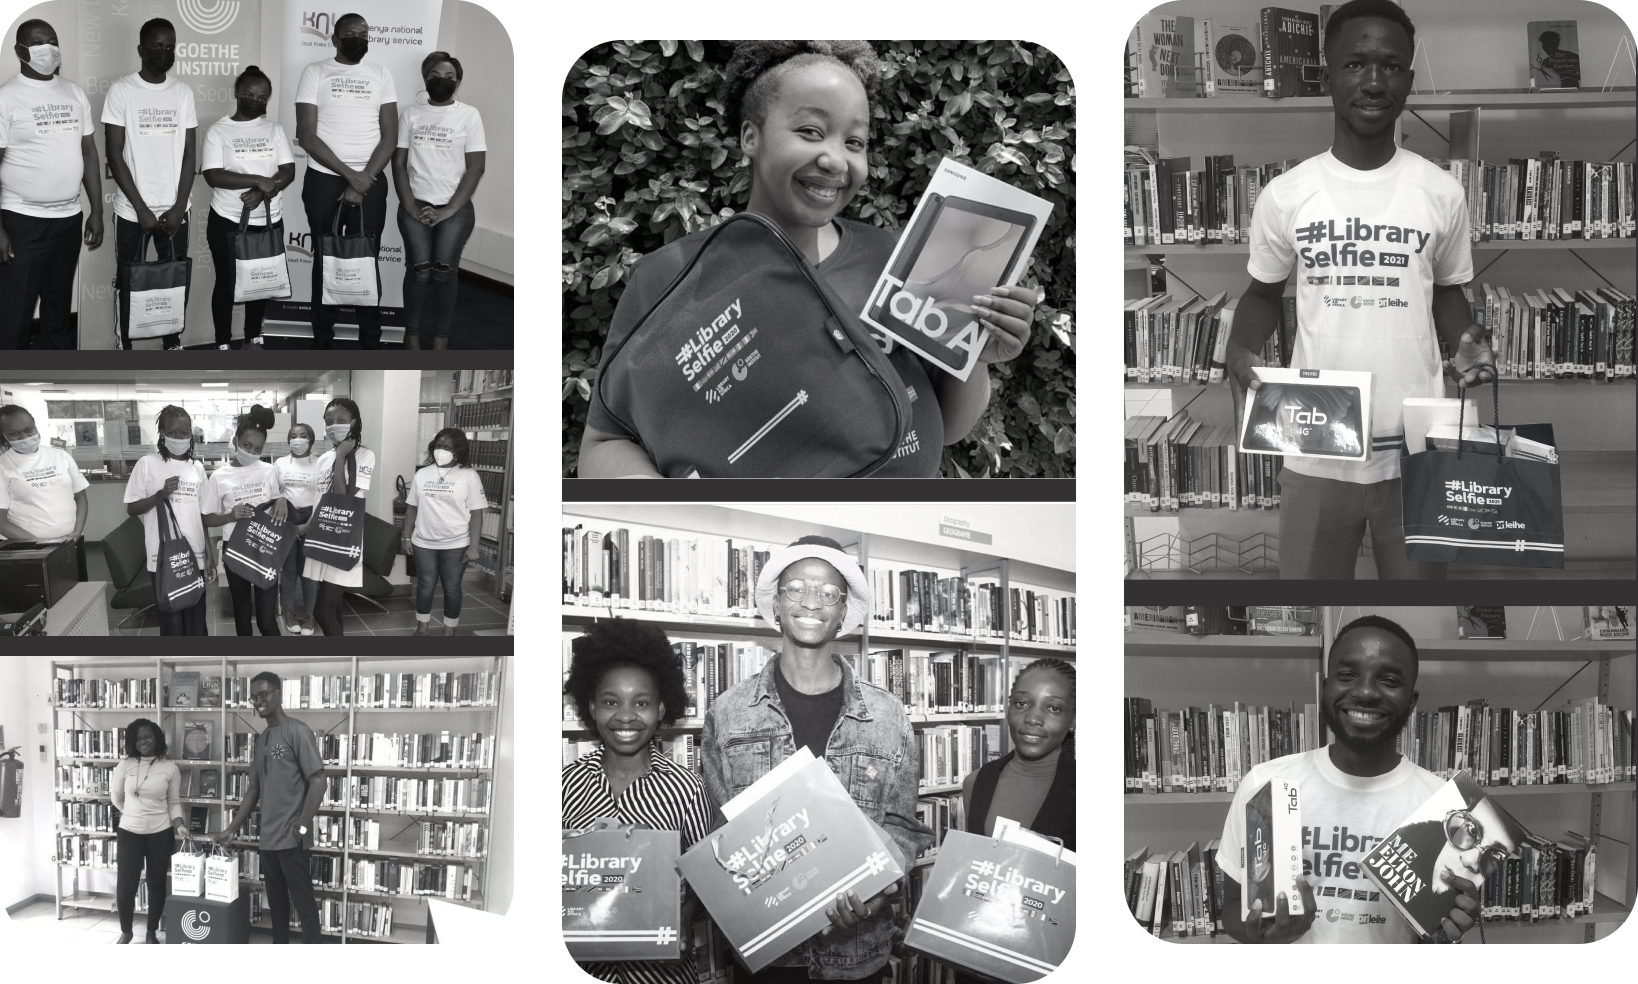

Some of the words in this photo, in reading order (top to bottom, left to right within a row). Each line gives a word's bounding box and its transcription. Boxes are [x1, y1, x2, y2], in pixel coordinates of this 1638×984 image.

[368, 25, 389, 34] enya
[391, 26, 423, 34] national
[1160, 20, 1175, 32] THE
[1282, 21, 1313, 36] ADICHIE
[368, 36, 390, 46] brary
[1154, 32, 1183, 46] WOMAN
[176, 43, 240, 58] GOETHE
[1160, 49, 1180, 64] NEXT
[176, 61, 240, 76] INSTITUT
[1218, 79, 1258, 87] AMERI
[197, 84, 236, 102] Seou
[31, 104, 73, 113] #Library
[34, 112, 60, 120] Selfie
[138, 108, 177, 116] #Library
[944, 167, 967, 180] SAMSUNG
[1296, 217, 1430, 254] #Library
[1300, 242, 1376, 268] Selfie
[1384, 256, 1404, 264] 2021
[876, 274, 948, 338] Tab
[675, 298, 742, 365] #Library
[682, 340, 723, 382] Selfie
[724, 328, 738, 342] 2020
[1284, 406, 1327, 425] Tab
[892, 441, 920, 458] TITUT
[1445, 480, 1512, 498] #Library
[1446, 491, 1485, 504] Selfie
[319, 512, 338, 520] Selfie
[321, 506, 354, 518] #Library
[943, 515, 970, 528] Geography
[250, 520, 282, 542] #Library
[943, 527, 972, 538] GEOGRAFIE
[202, 680, 219, 688] LINK
[1288, 788, 1298, 814] Tab
[786, 837, 804, 853] 2020
[1254, 828, 1262, 876] Tab
[1389, 834, 1418, 864] ME
[1302, 852, 1360, 880] elfie
[1379, 844, 1426, 894] ELTON
[562, 870, 602, 885] elfie
[970, 860, 1066, 904] #Library
[1370, 858, 1416, 904] JOHN
[1024, 898, 1042, 908] 2020
